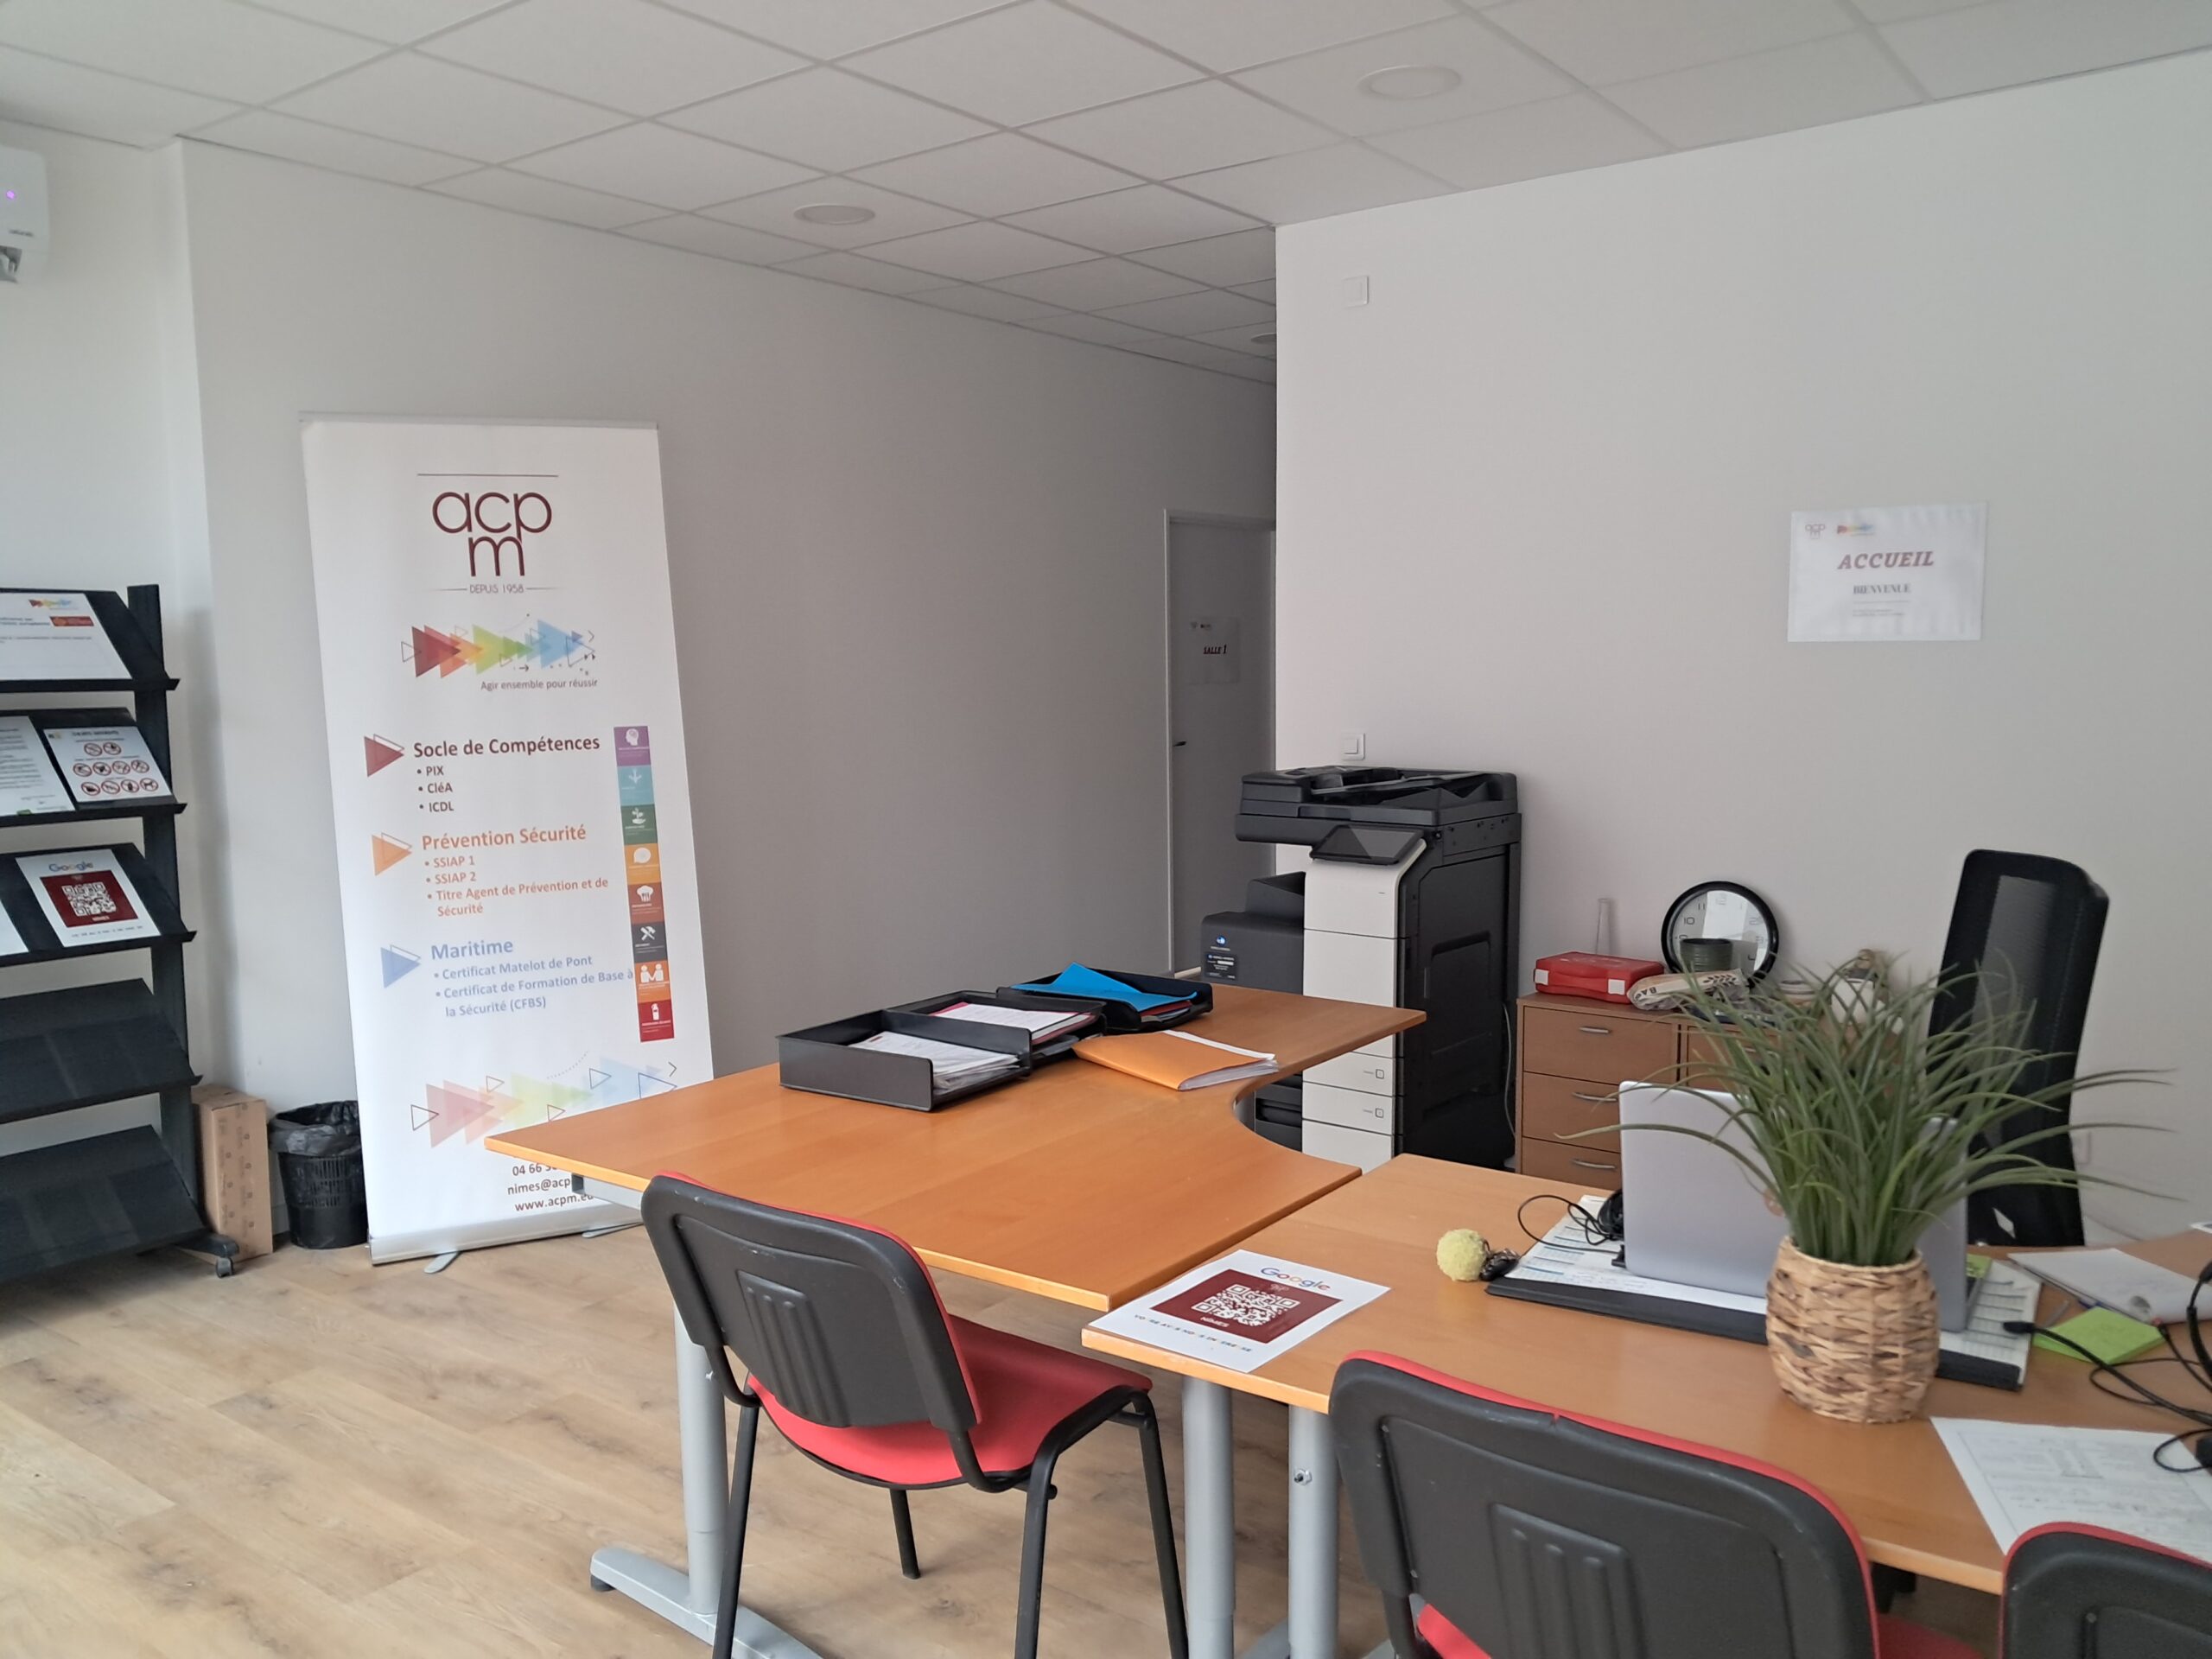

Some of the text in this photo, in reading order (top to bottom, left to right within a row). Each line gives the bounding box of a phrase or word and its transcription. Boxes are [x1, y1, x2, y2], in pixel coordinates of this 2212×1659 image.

[432, 492, 552, 543] acp
[468, 537, 525, 576] m
[1837, 551, 1934, 569] ACCUEIL
[470, 584, 524, 594] DEPUIS 1958
[1853, 583, 1911, 594] BIENVENUE
[480, 677, 598, 691] Agir ensemble pour réussir
[414, 741, 458, 758] Socle
[463, 739, 484, 754] de
[488, 736, 601, 756] Compétences
[426, 766, 444, 776] PIX
[427, 782, 453, 793] CléA
[429, 801, 454, 812] ICDL
[422, 823, 587, 850] Prévention Sécurité
[48, 861, 93, 872] Google
[434, 856, 474, 868] SSIAP 1
[435, 872, 476, 884] SSIAP 2
[436, 877, 609, 901] Titre Agent de Prévention et de
[437, 902, 483, 917] Sécurité
[1684, 917, 1695, 925] 10
[431, 939, 513, 959] Maritime
[442, 955, 593, 980] Certificat Matelot de Pont
[443, 968, 633, 999] Certificat de Formation de Base à
[445, 996, 546, 1017] la Sécurité (CFBS)
[512, 1163, 542, 1176] 04 66
[507, 1178, 570, 1195] nimes@acp
[1261, 1268, 1331, 1291] Google
